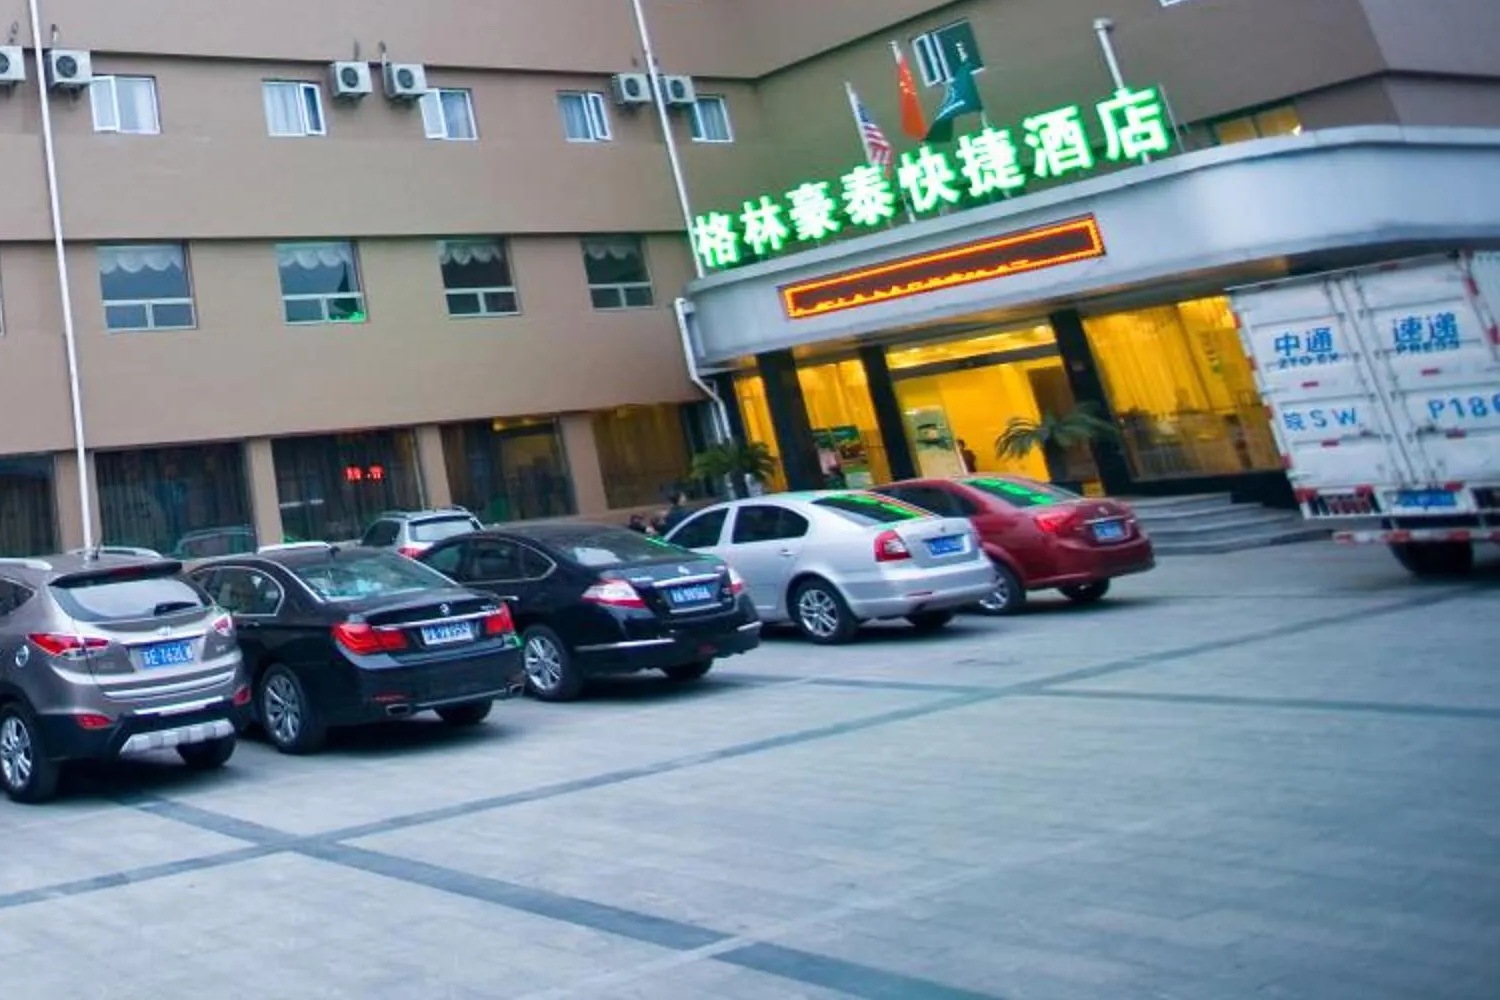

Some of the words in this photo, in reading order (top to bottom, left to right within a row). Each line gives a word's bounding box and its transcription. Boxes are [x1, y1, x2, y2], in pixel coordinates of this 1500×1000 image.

[693, 87, 1171, 267] 格林豪泰快捷酒店
[1274, 327, 1333, 356] 中通
